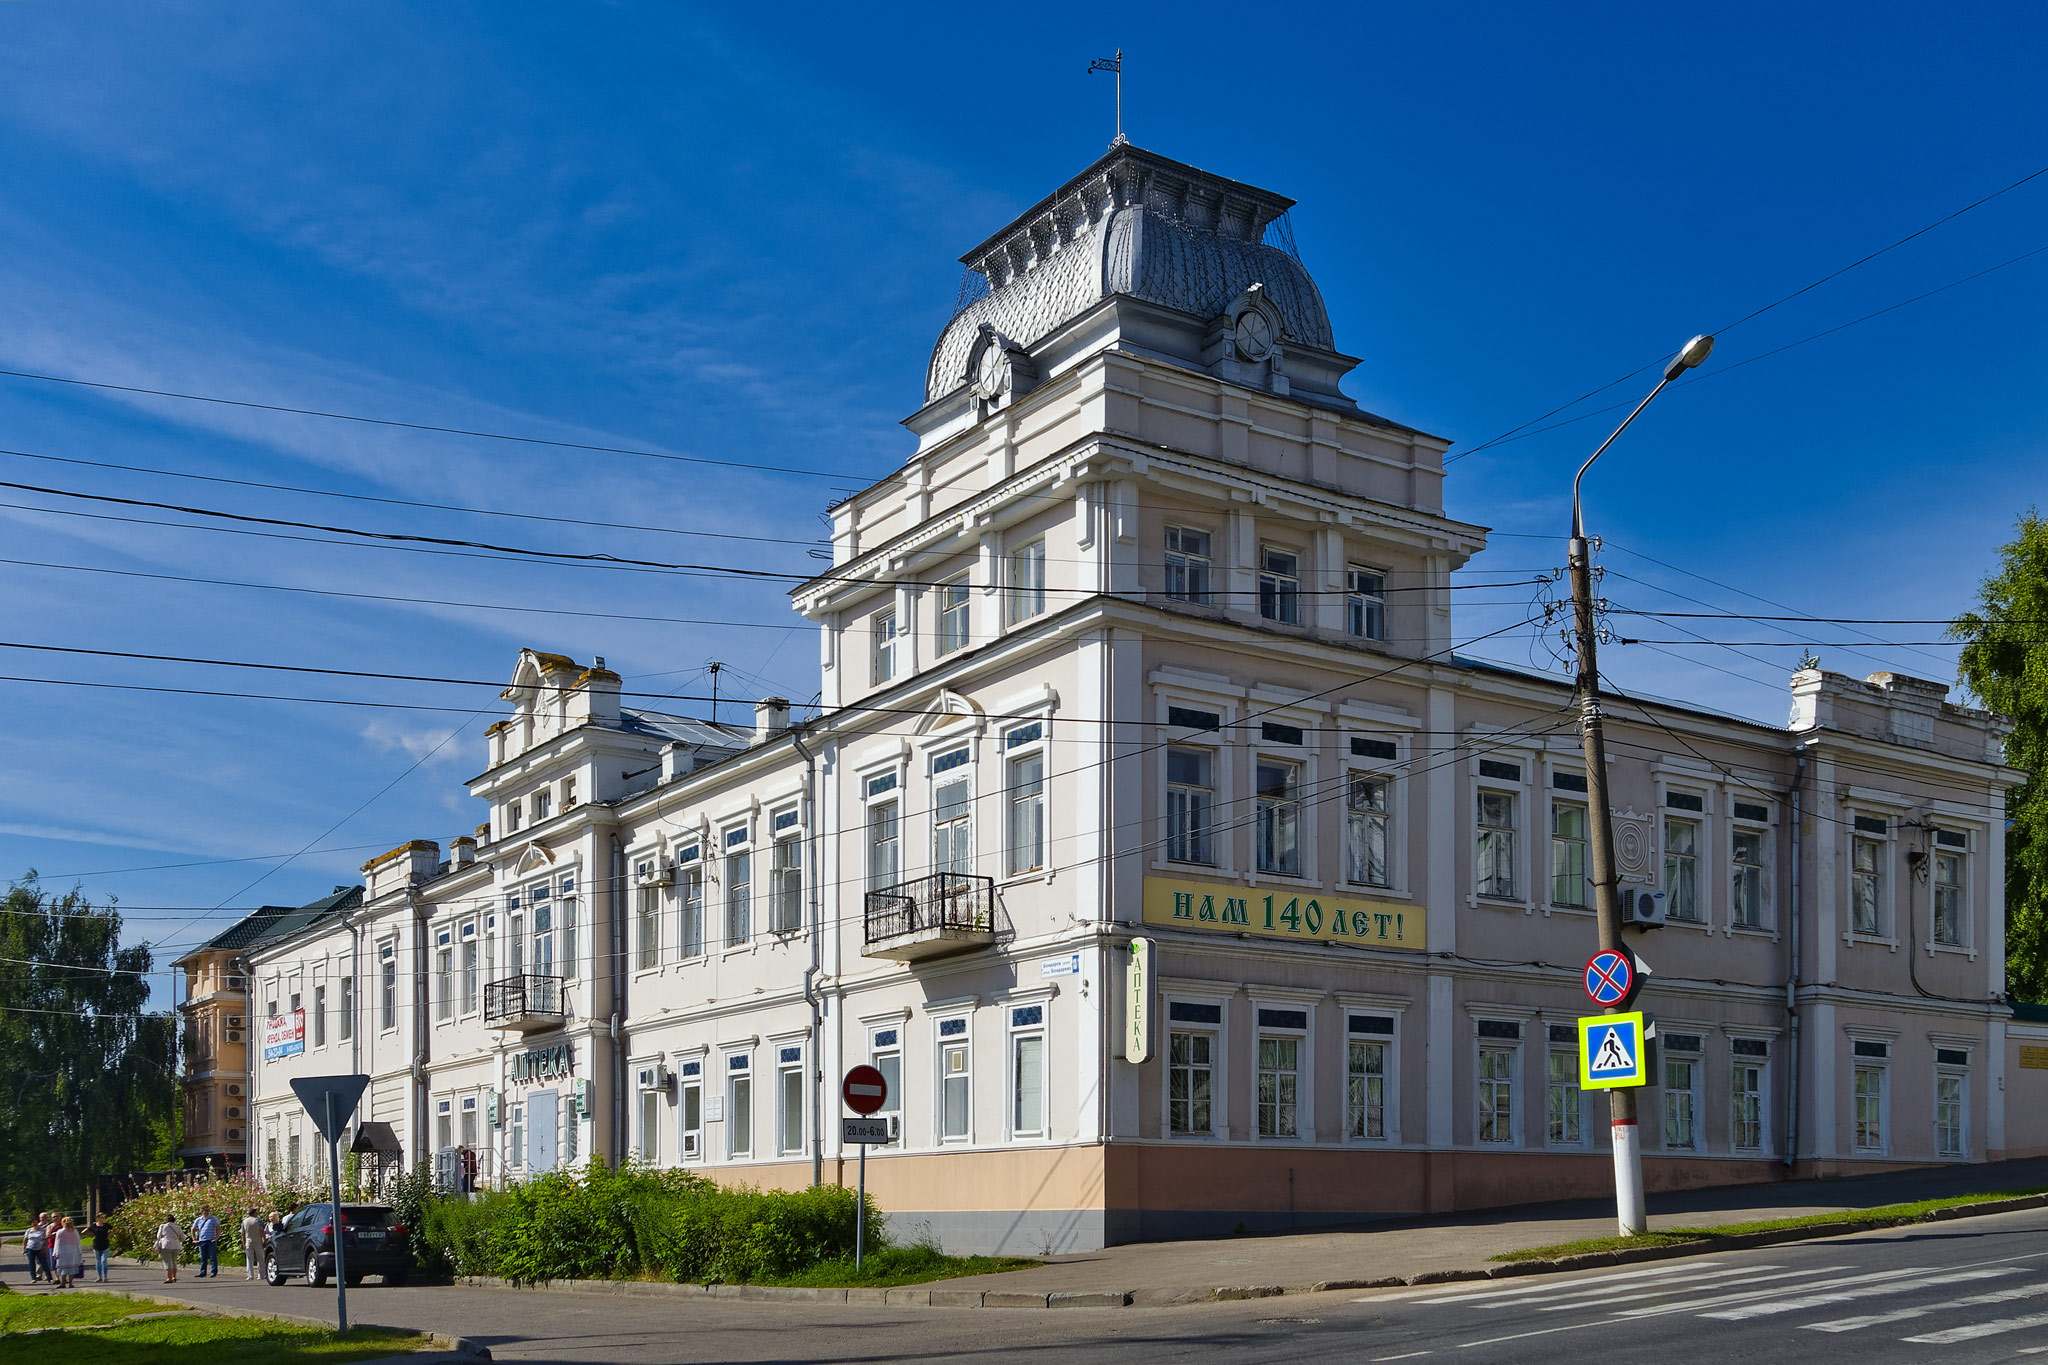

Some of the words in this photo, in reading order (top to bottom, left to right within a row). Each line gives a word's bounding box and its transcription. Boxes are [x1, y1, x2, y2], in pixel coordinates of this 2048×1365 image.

[1173, 891, 1250, 925] НАМ
[1262, 892, 1324, 934] 140
[1332, 908, 1404, 940] ЛЕТ!
[1133, 957, 1142, 1052] АПТЕКА
[510, 1044, 569, 1081] АПТЕКА
[847, 1125, 885, 1137] 20.00-6.00
